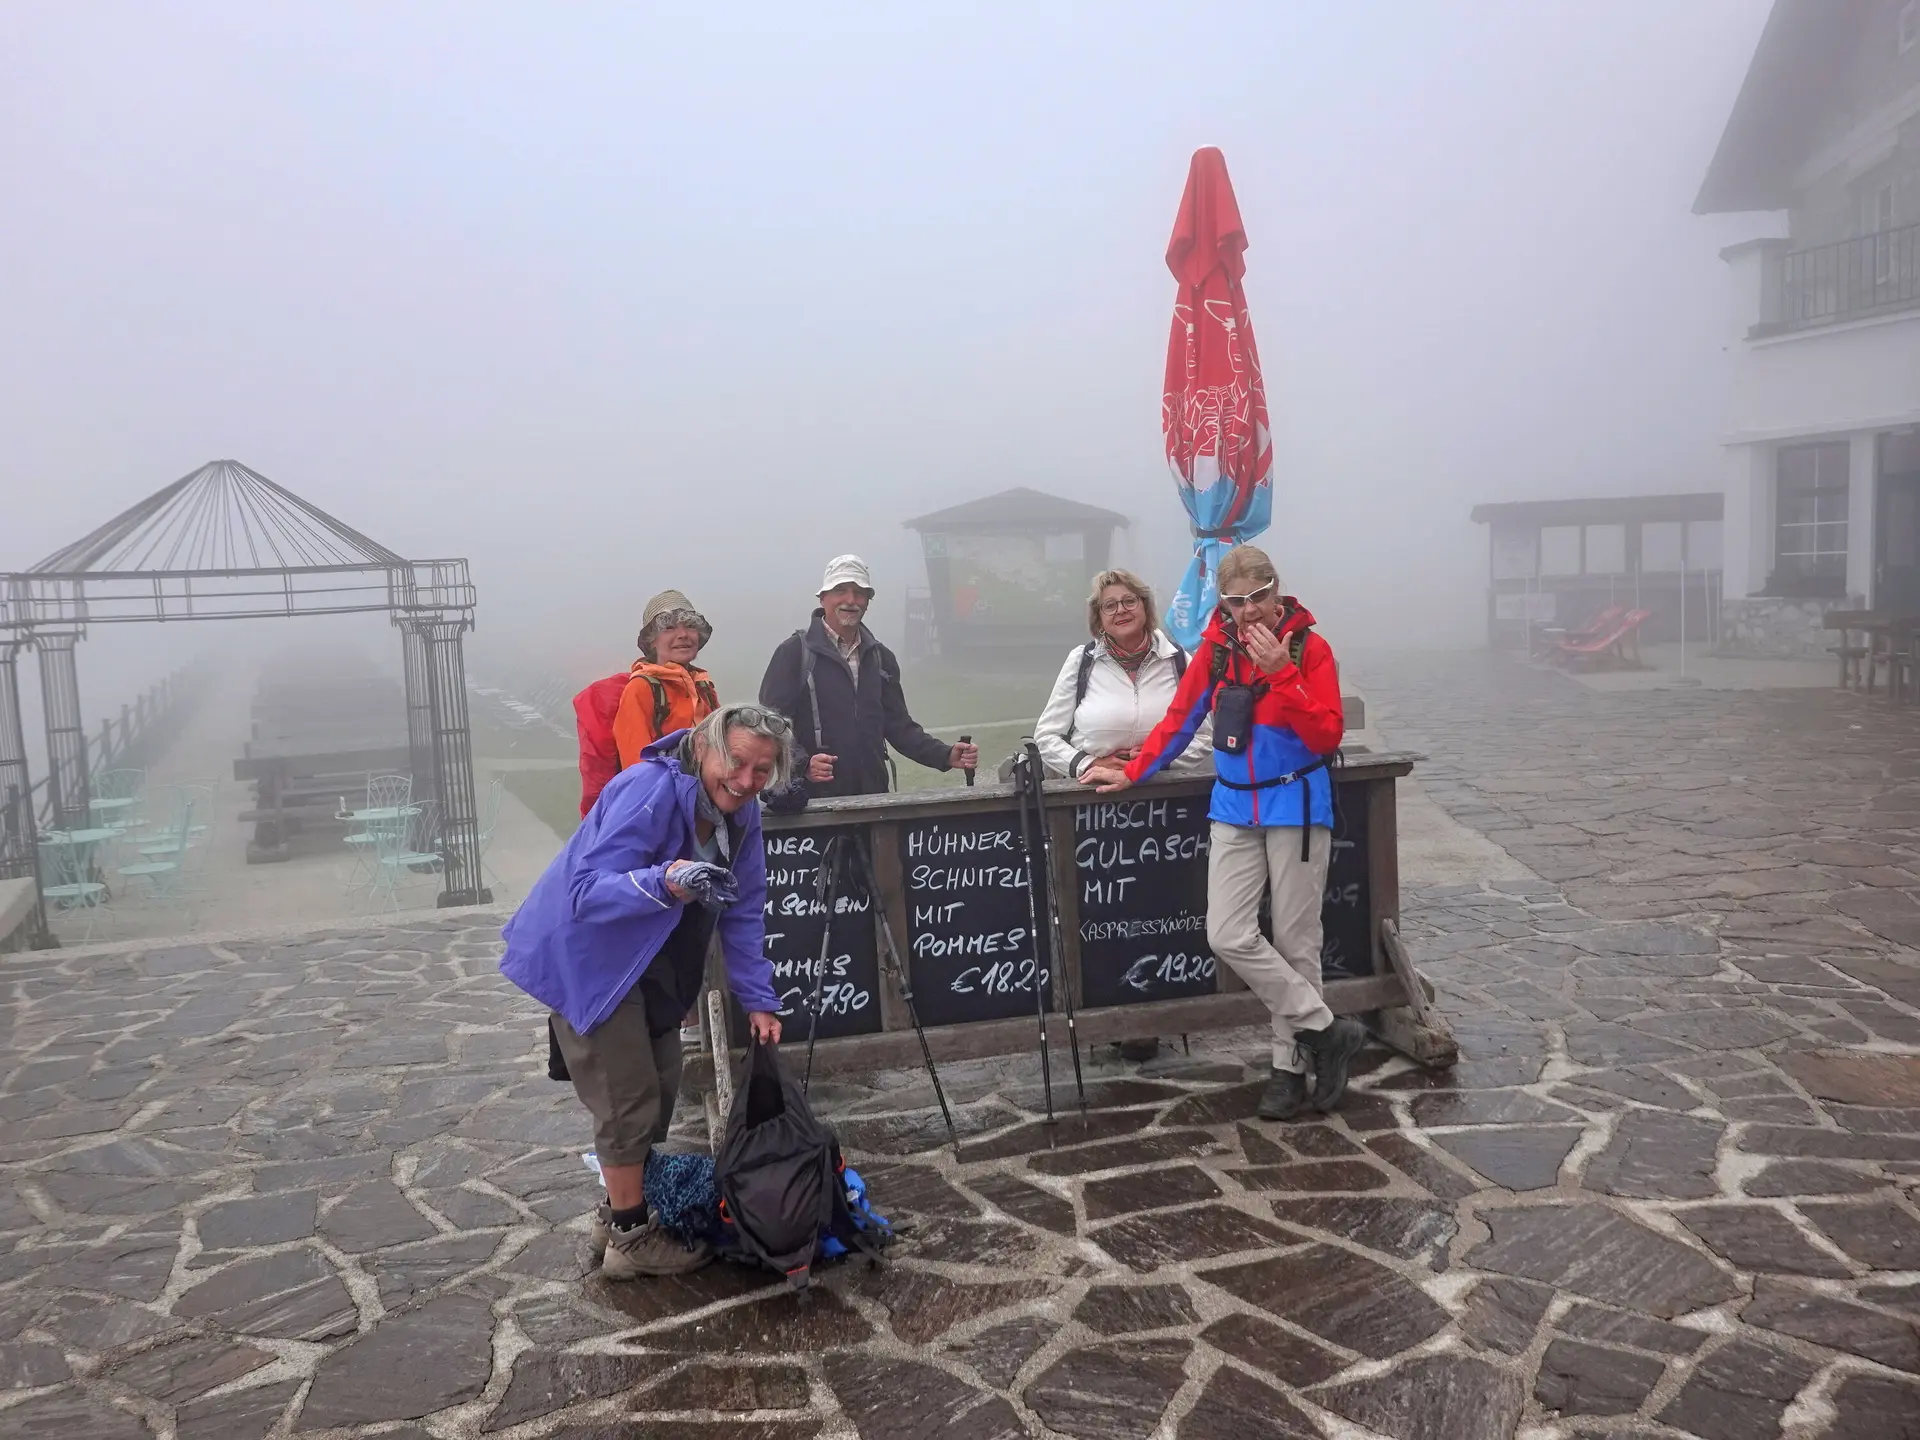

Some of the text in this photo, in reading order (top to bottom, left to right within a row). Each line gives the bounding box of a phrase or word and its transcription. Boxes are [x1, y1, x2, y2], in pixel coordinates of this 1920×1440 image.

[908, 825, 1015, 857] HÜHNER
[1075, 834, 1211, 870] GULASCH
[910, 864, 1028, 891] SCHNITZL
[1084, 876, 1137, 904] MIT
[915, 901, 965, 928] MIT
[913, 927, 1026, 958] POMMES
[772, 953, 852, 984] MMES
